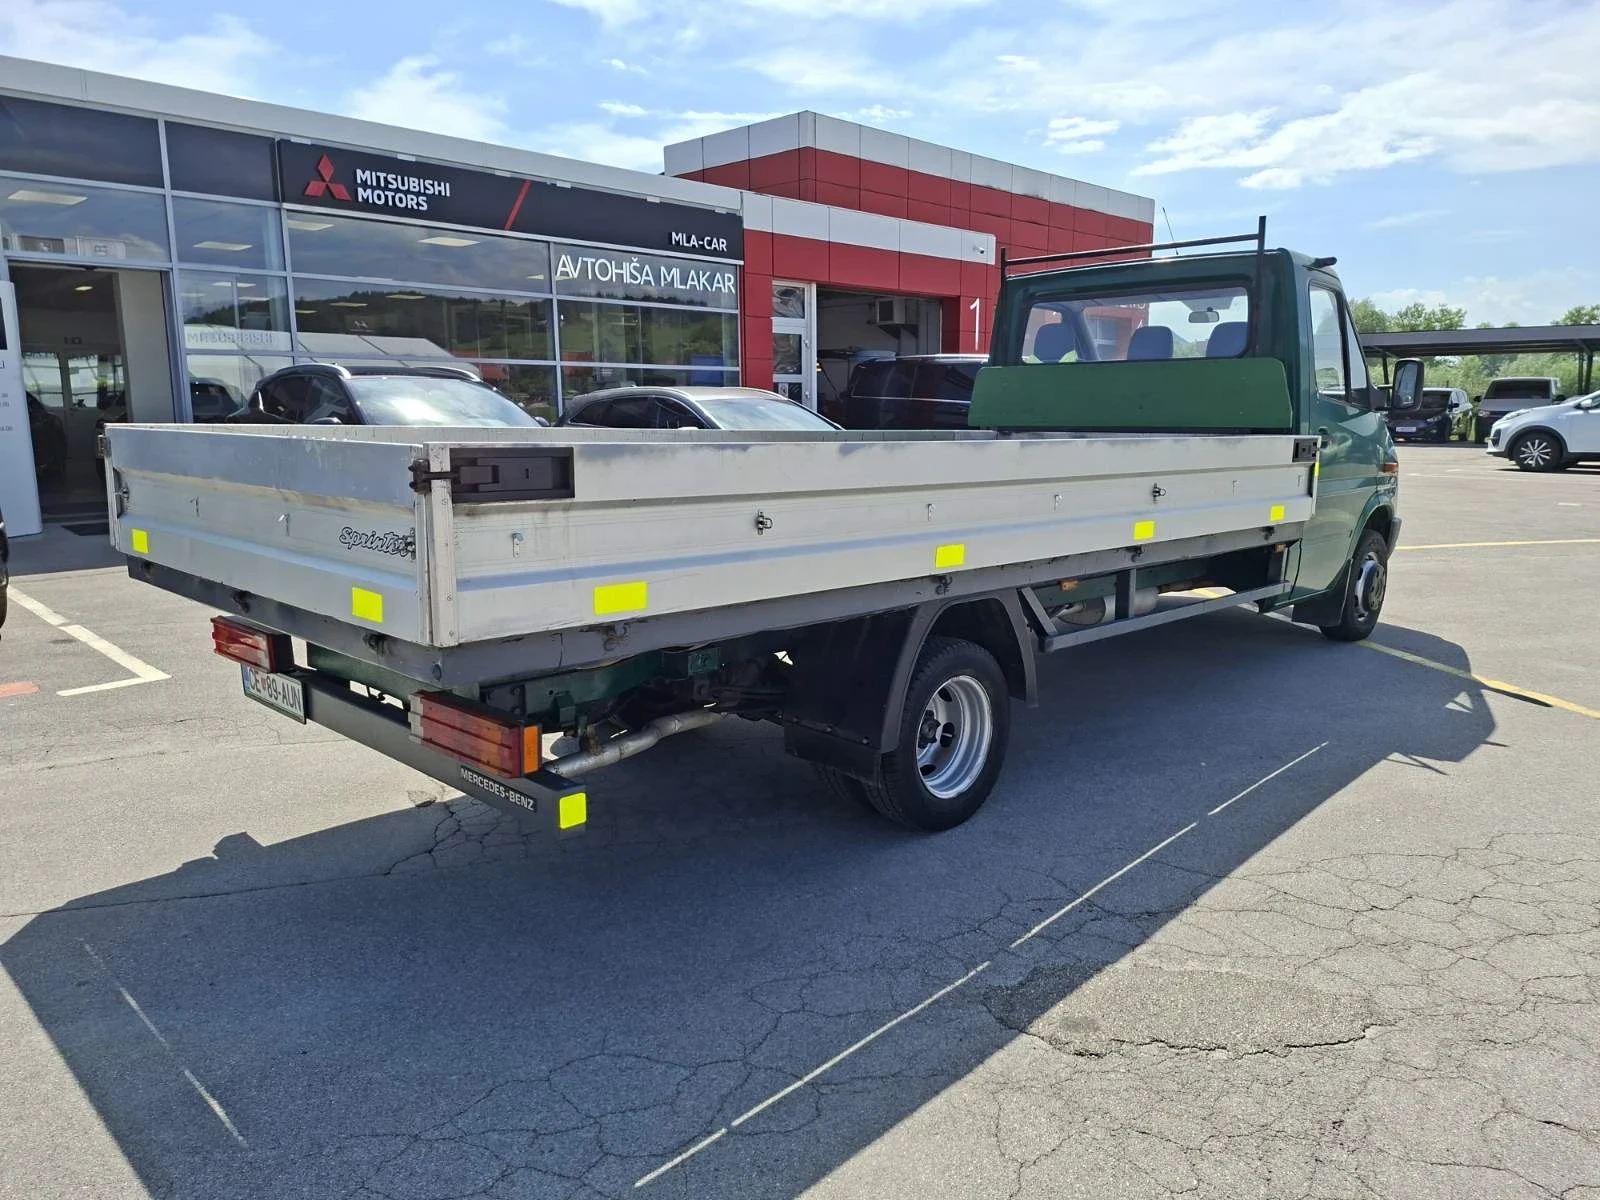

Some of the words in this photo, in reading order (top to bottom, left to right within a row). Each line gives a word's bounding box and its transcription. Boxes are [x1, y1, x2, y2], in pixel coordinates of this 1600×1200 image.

[356, 168, 450, 197] MITSUBISHI
[357, 187, 428, 211] MOTORS
[671, 231, 727, 252] MLA-CAR
[556, 254, 655, 287] AVTOHIŠA
[660, 266, 736, 294] MLAKAR
[969, 297, 980, 351] 1
[249, 668, 261, 694] CE
[266, 675, 302, 713] 89-AUN
